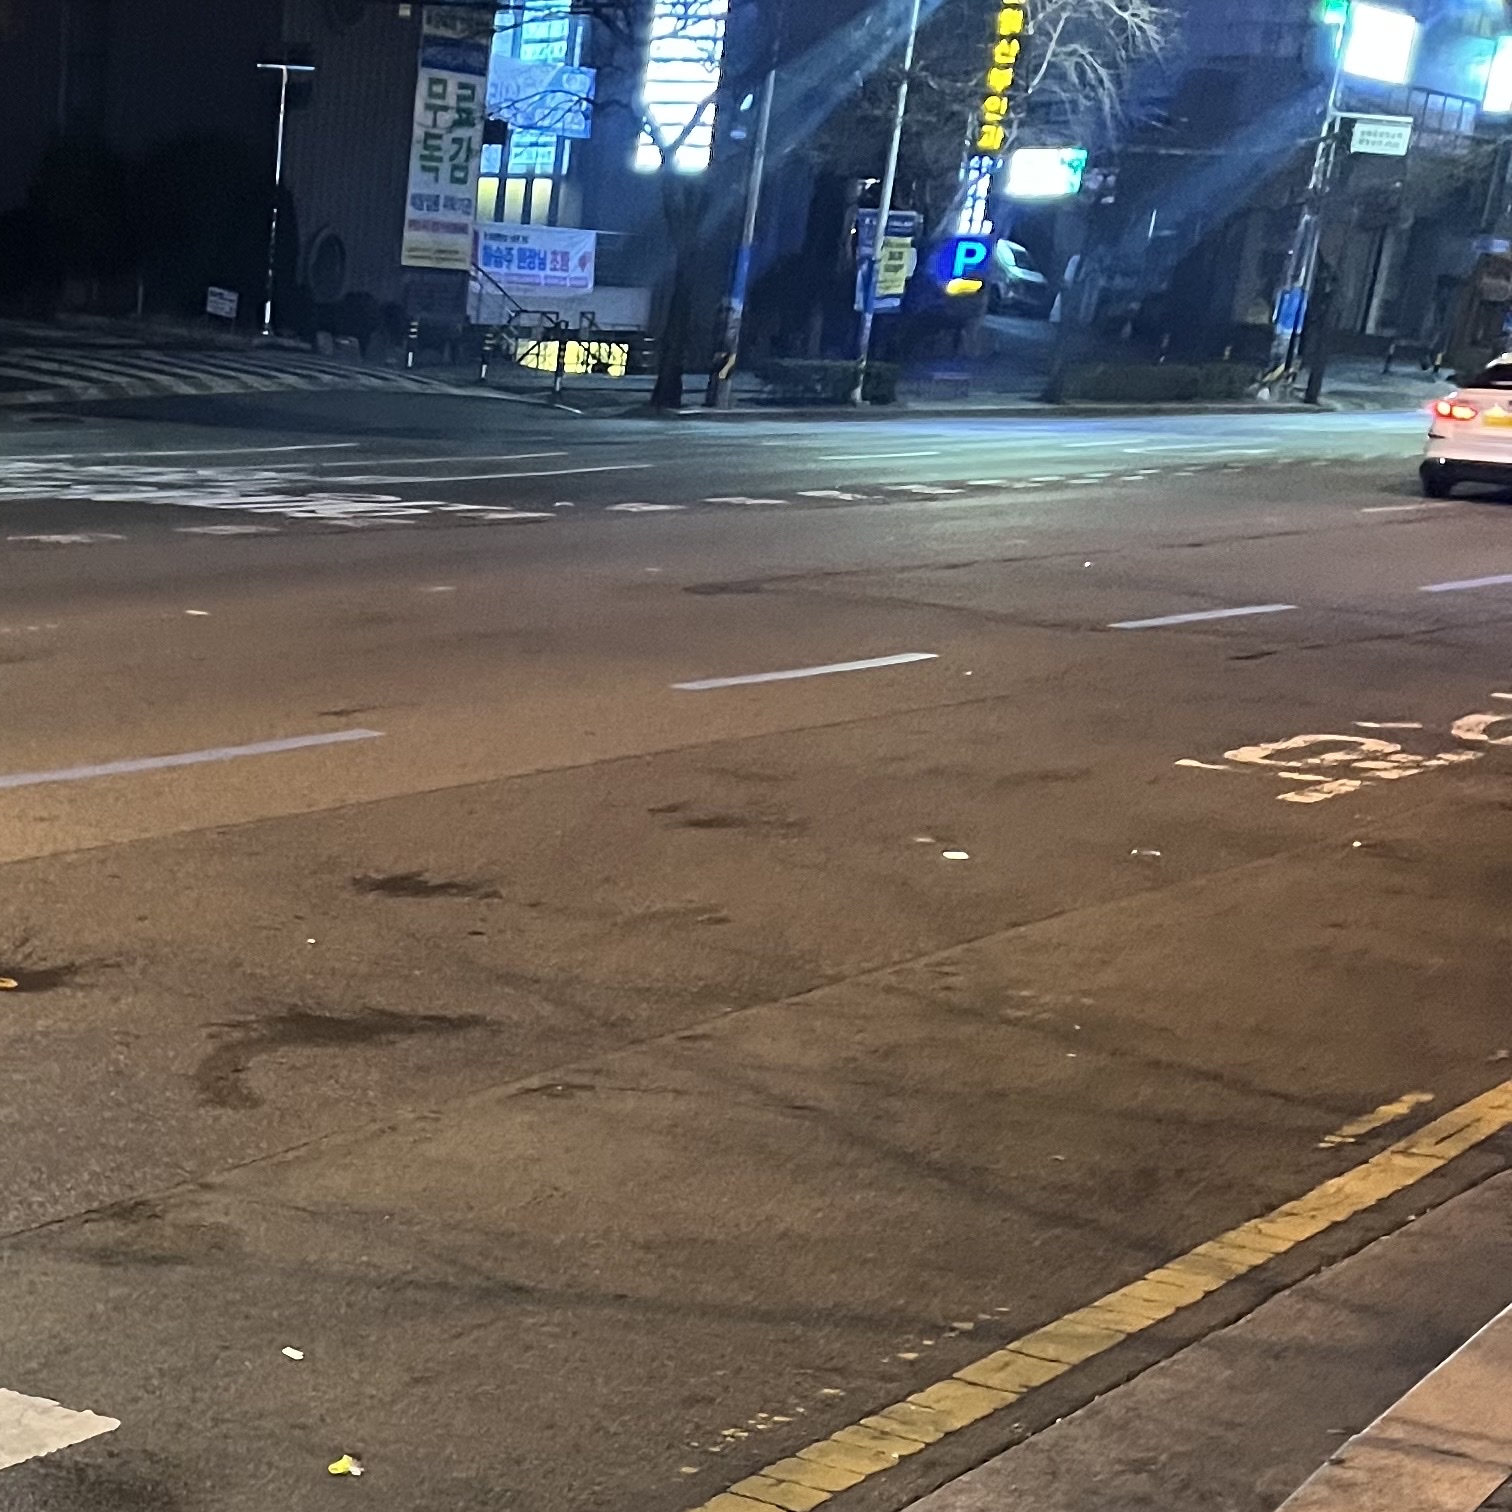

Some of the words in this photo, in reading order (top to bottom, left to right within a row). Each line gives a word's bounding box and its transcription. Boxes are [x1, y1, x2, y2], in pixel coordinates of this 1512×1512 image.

[424, 76, 476, 129] 무료
[419, 130, 473, 186] 독감
[951, 240, 987, 278] P
